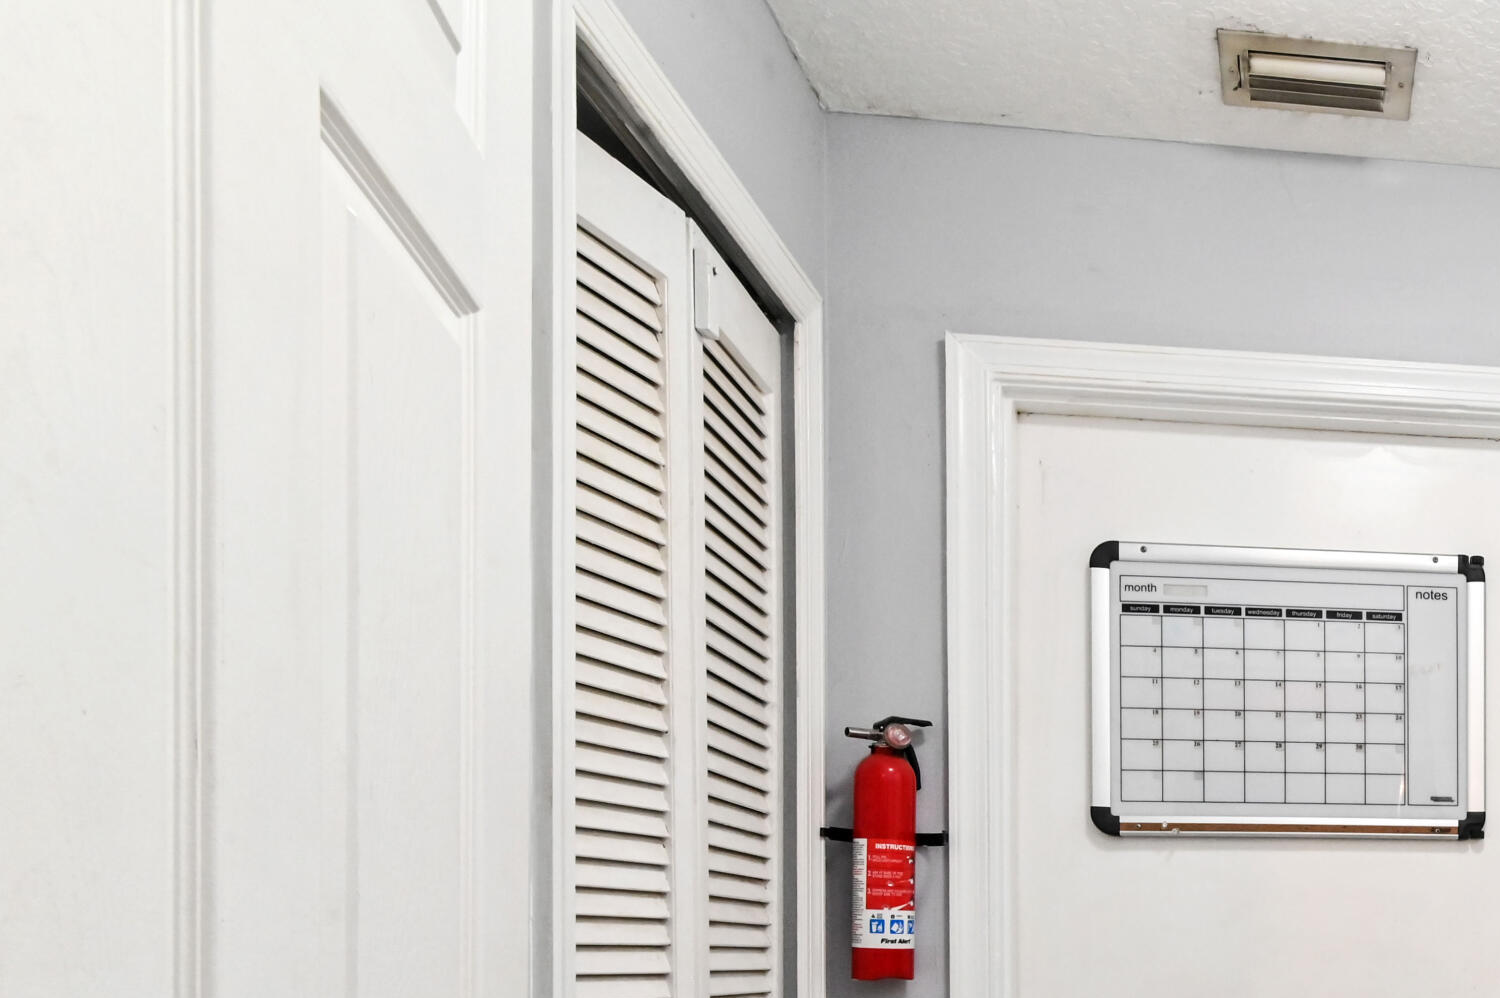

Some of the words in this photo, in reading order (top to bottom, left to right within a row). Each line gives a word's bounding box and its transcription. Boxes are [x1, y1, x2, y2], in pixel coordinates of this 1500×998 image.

[1124, 583, 1157, 592] month
[1415, 590, 1448, 600] notes
[1170, 606, 1194, 614] monday
